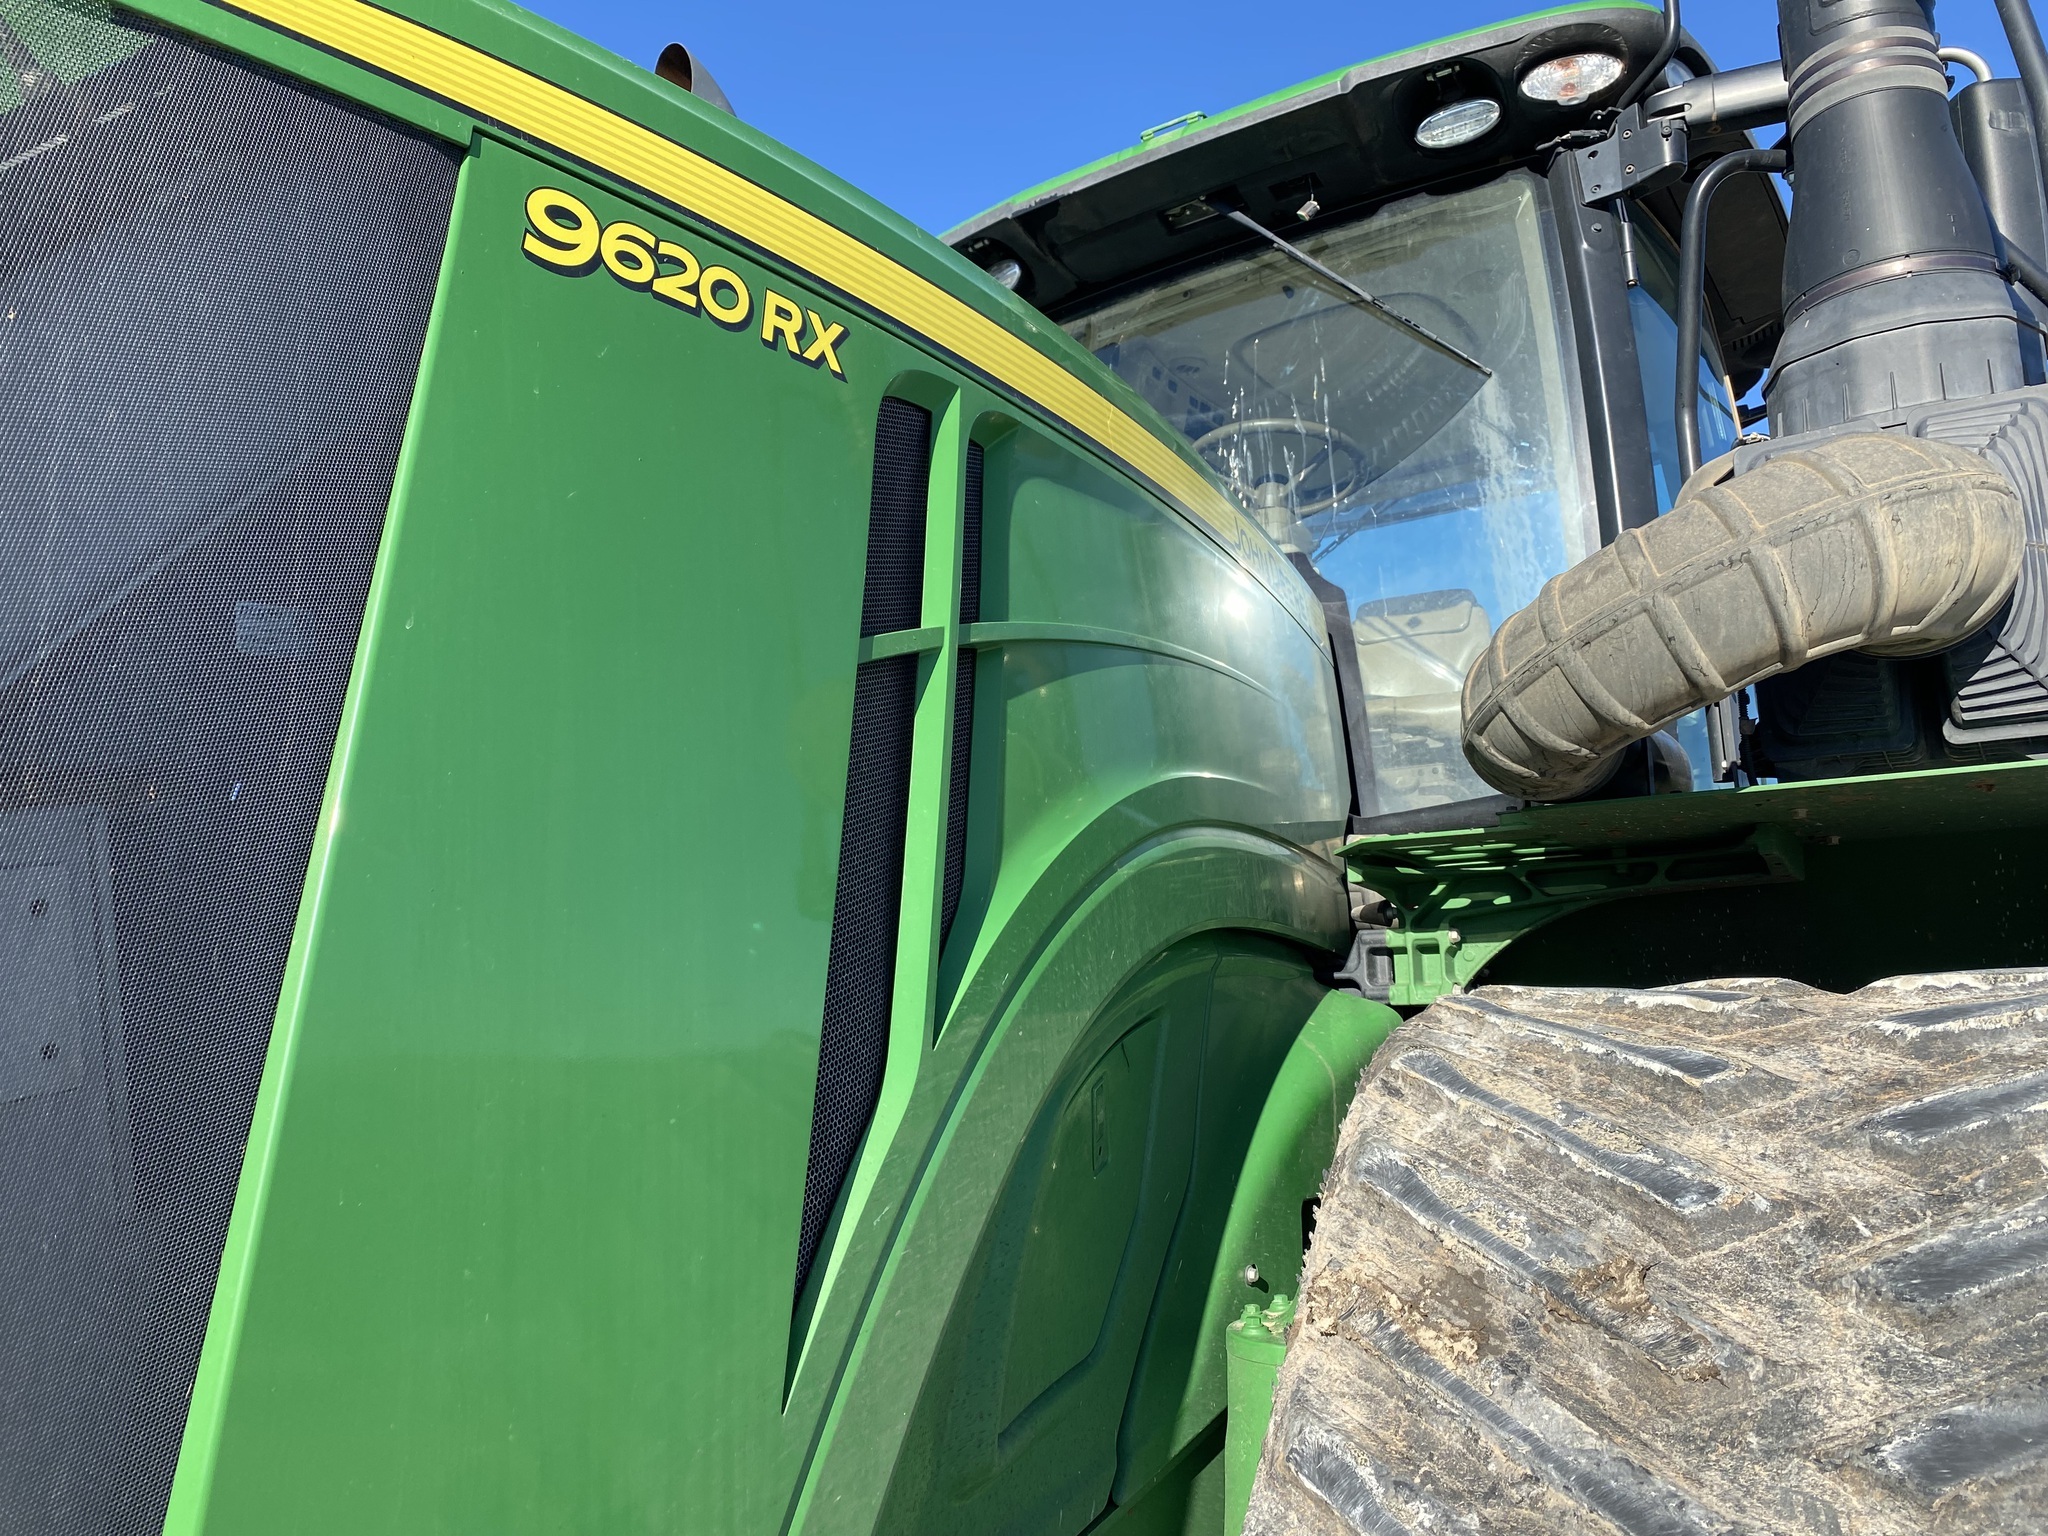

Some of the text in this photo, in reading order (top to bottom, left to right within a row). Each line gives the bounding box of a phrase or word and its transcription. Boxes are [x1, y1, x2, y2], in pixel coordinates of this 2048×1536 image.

[522, 186, 849, 382] 9620 RX
[1233, 515, 1272, 580] JOHN
